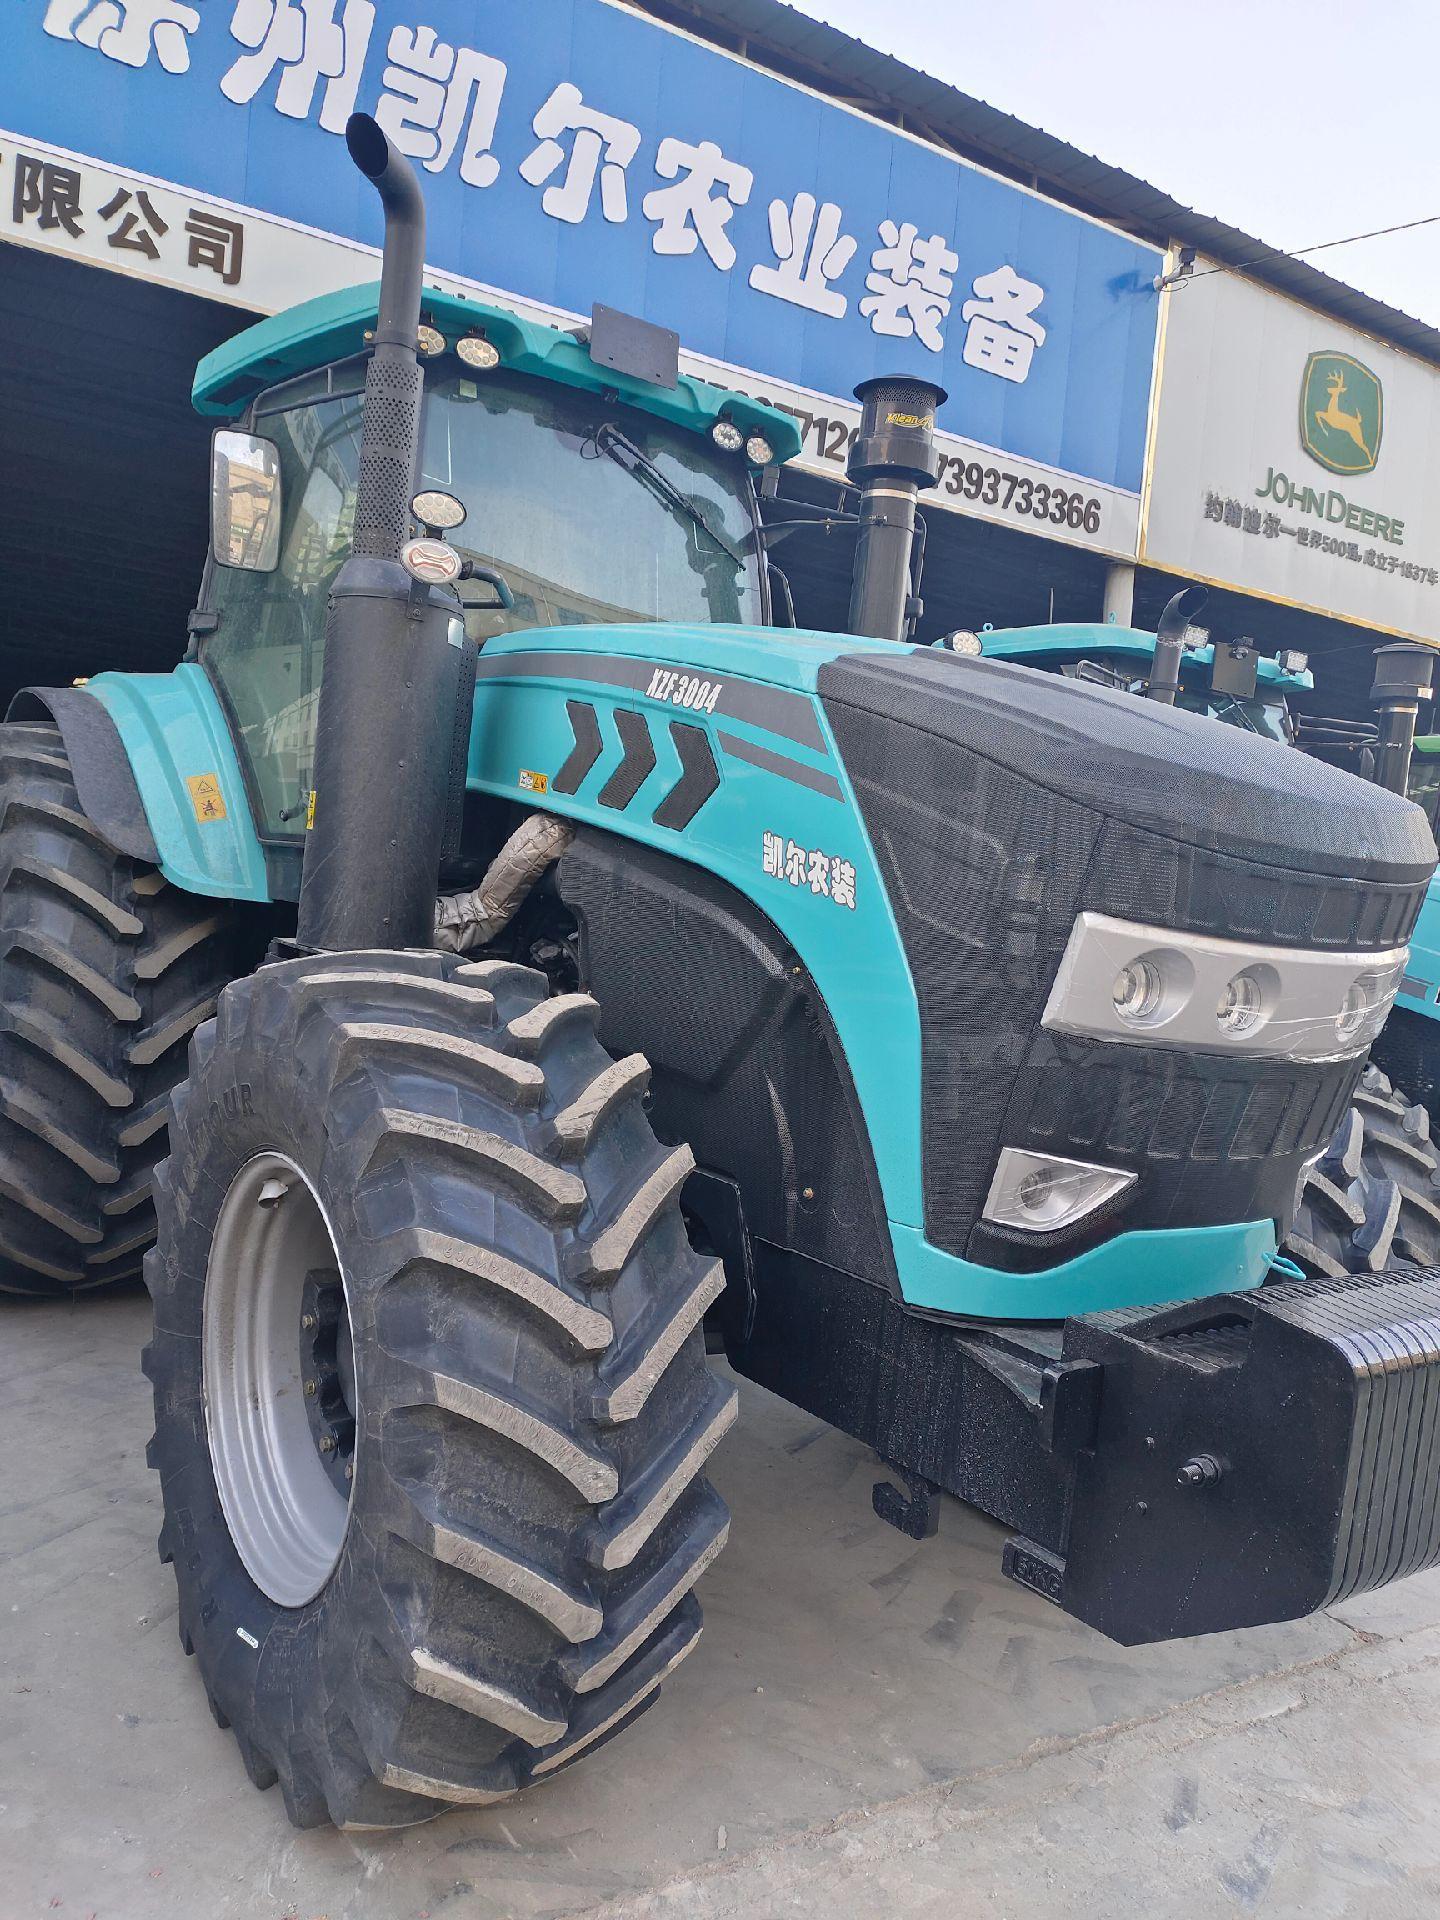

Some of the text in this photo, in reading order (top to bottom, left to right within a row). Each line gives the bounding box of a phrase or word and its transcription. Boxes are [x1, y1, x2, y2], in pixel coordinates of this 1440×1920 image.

[646, 668, 723, 714] XZF3004
[763, 831, 855, 910] 凯尔农装
